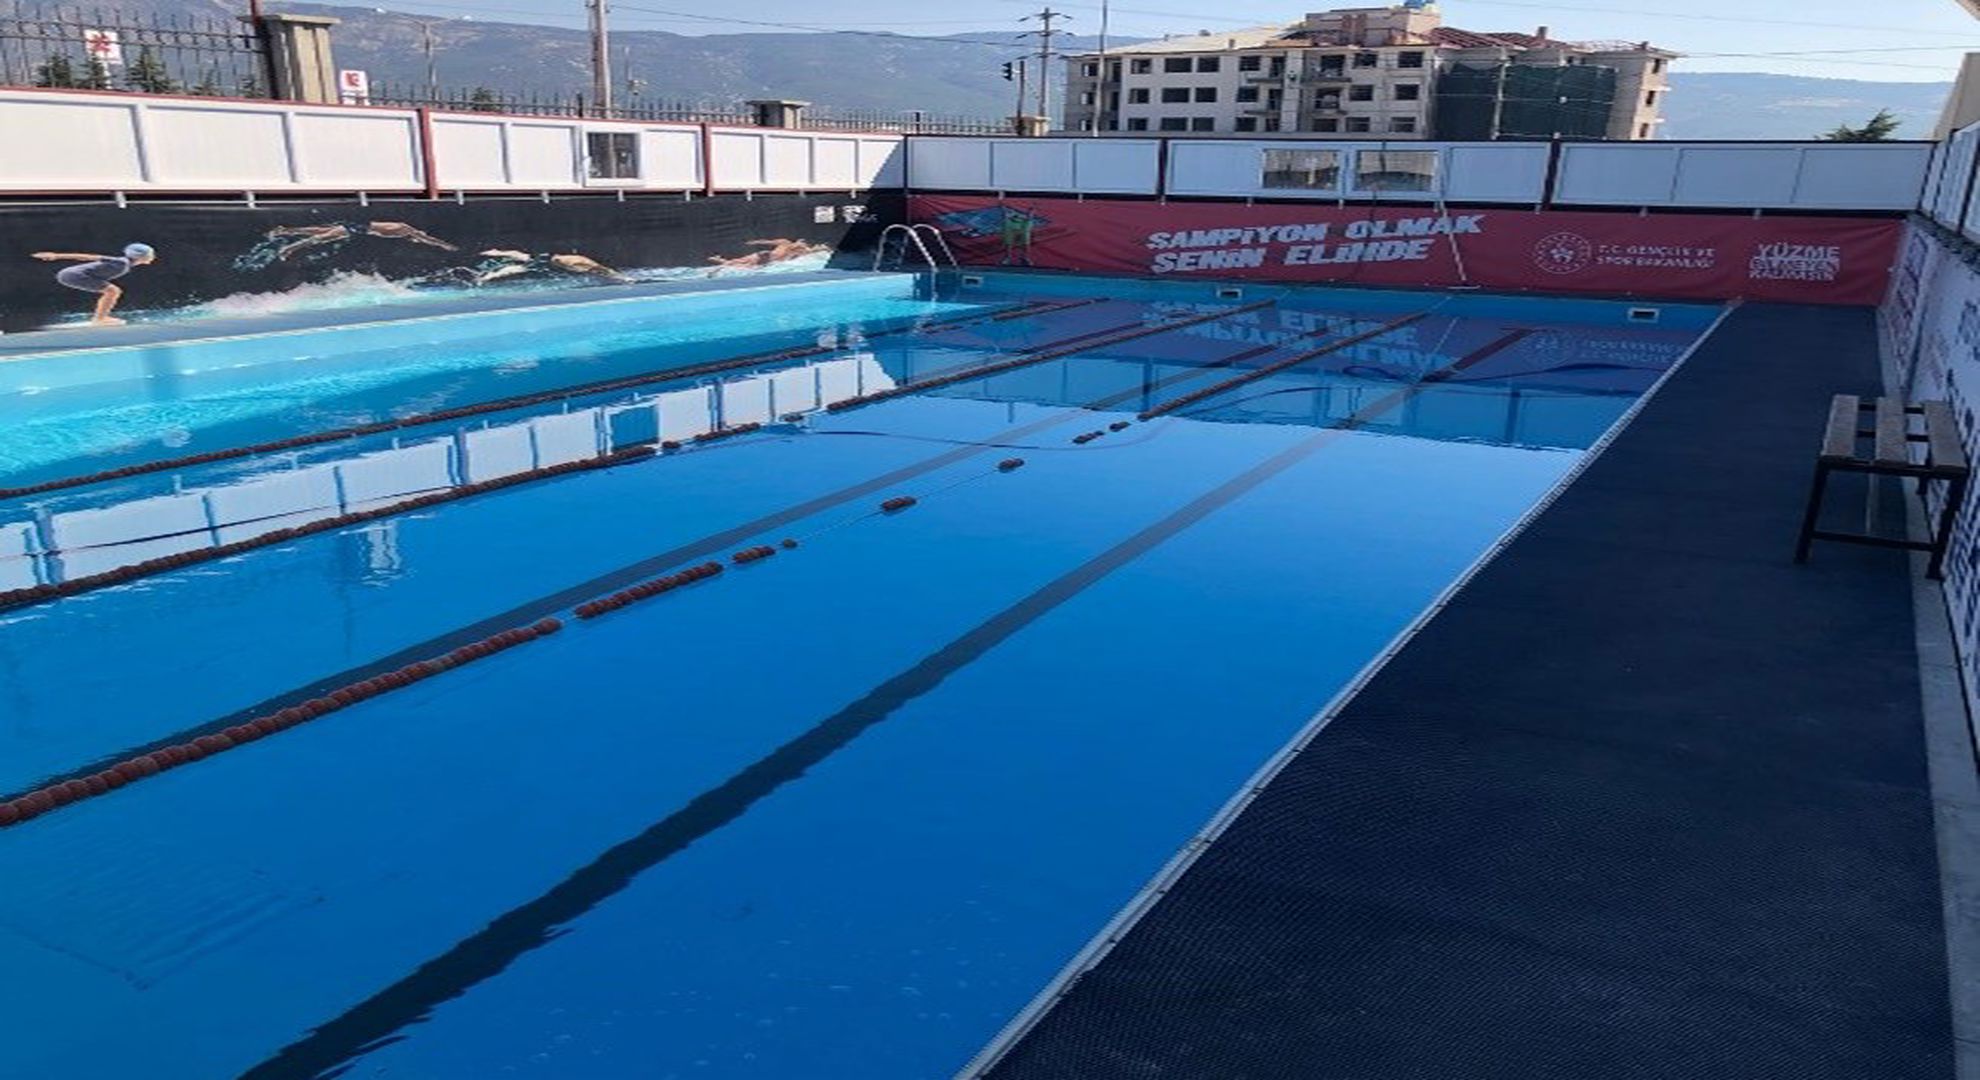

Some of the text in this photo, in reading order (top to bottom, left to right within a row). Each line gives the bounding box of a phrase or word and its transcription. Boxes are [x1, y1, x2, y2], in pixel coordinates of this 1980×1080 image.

[1345, 214, 1485, 239] OLMAK
[1283, 239, 1436, 266] ELİNDE
[1758, 242, 1840, 260] YÜZME
